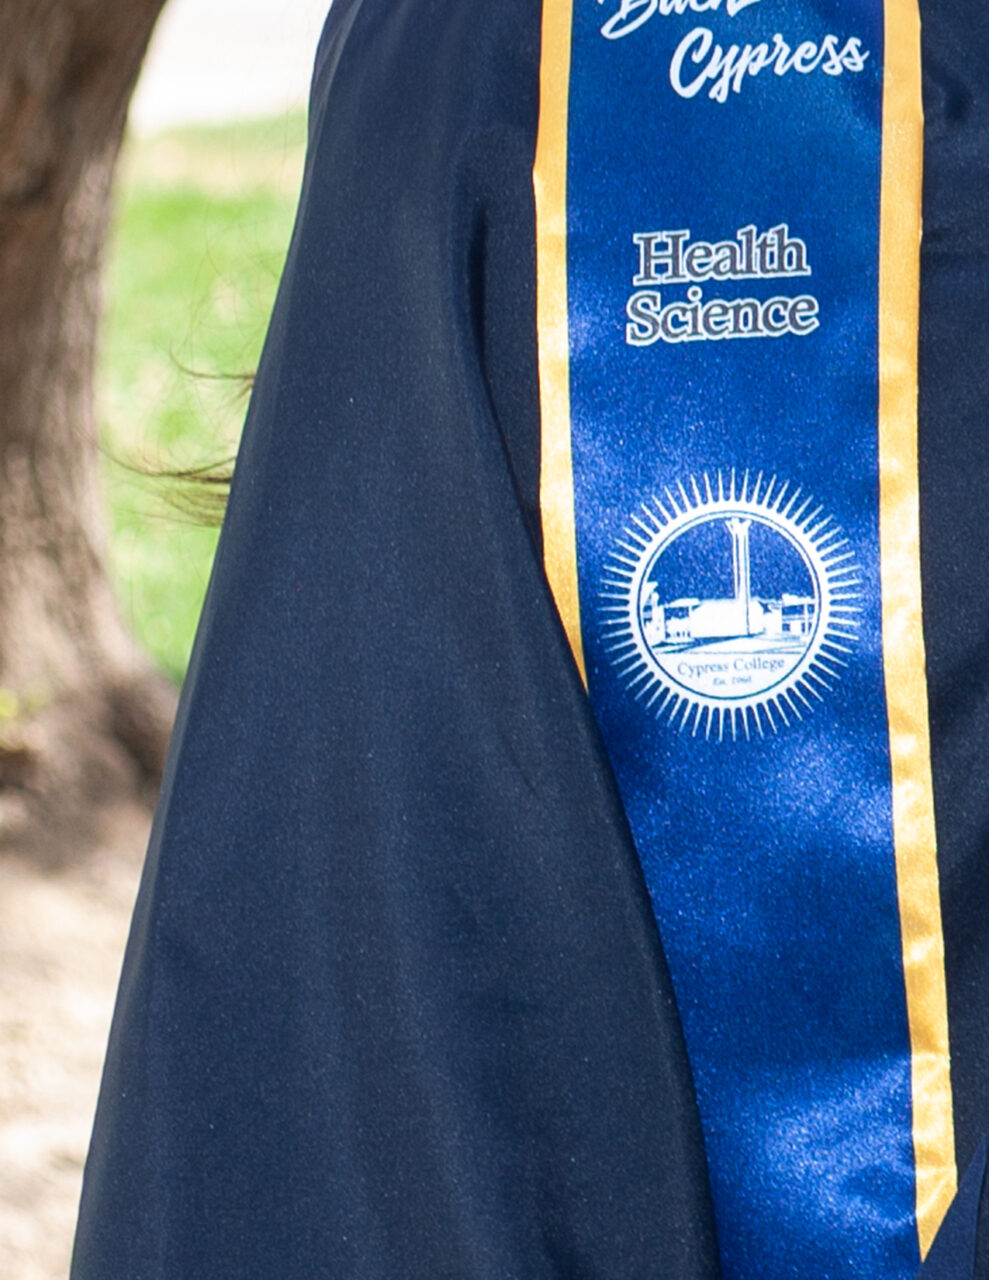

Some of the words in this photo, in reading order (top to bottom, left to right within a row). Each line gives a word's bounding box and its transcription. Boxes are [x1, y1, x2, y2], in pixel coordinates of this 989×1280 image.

[669, 27, 870, 103] Cypress
[633, 223, 811, 286] Health
[626, 286, 819, 346] Science
[677, 661, 728, 678] Cypress
[733, 657, 785, 671] College
